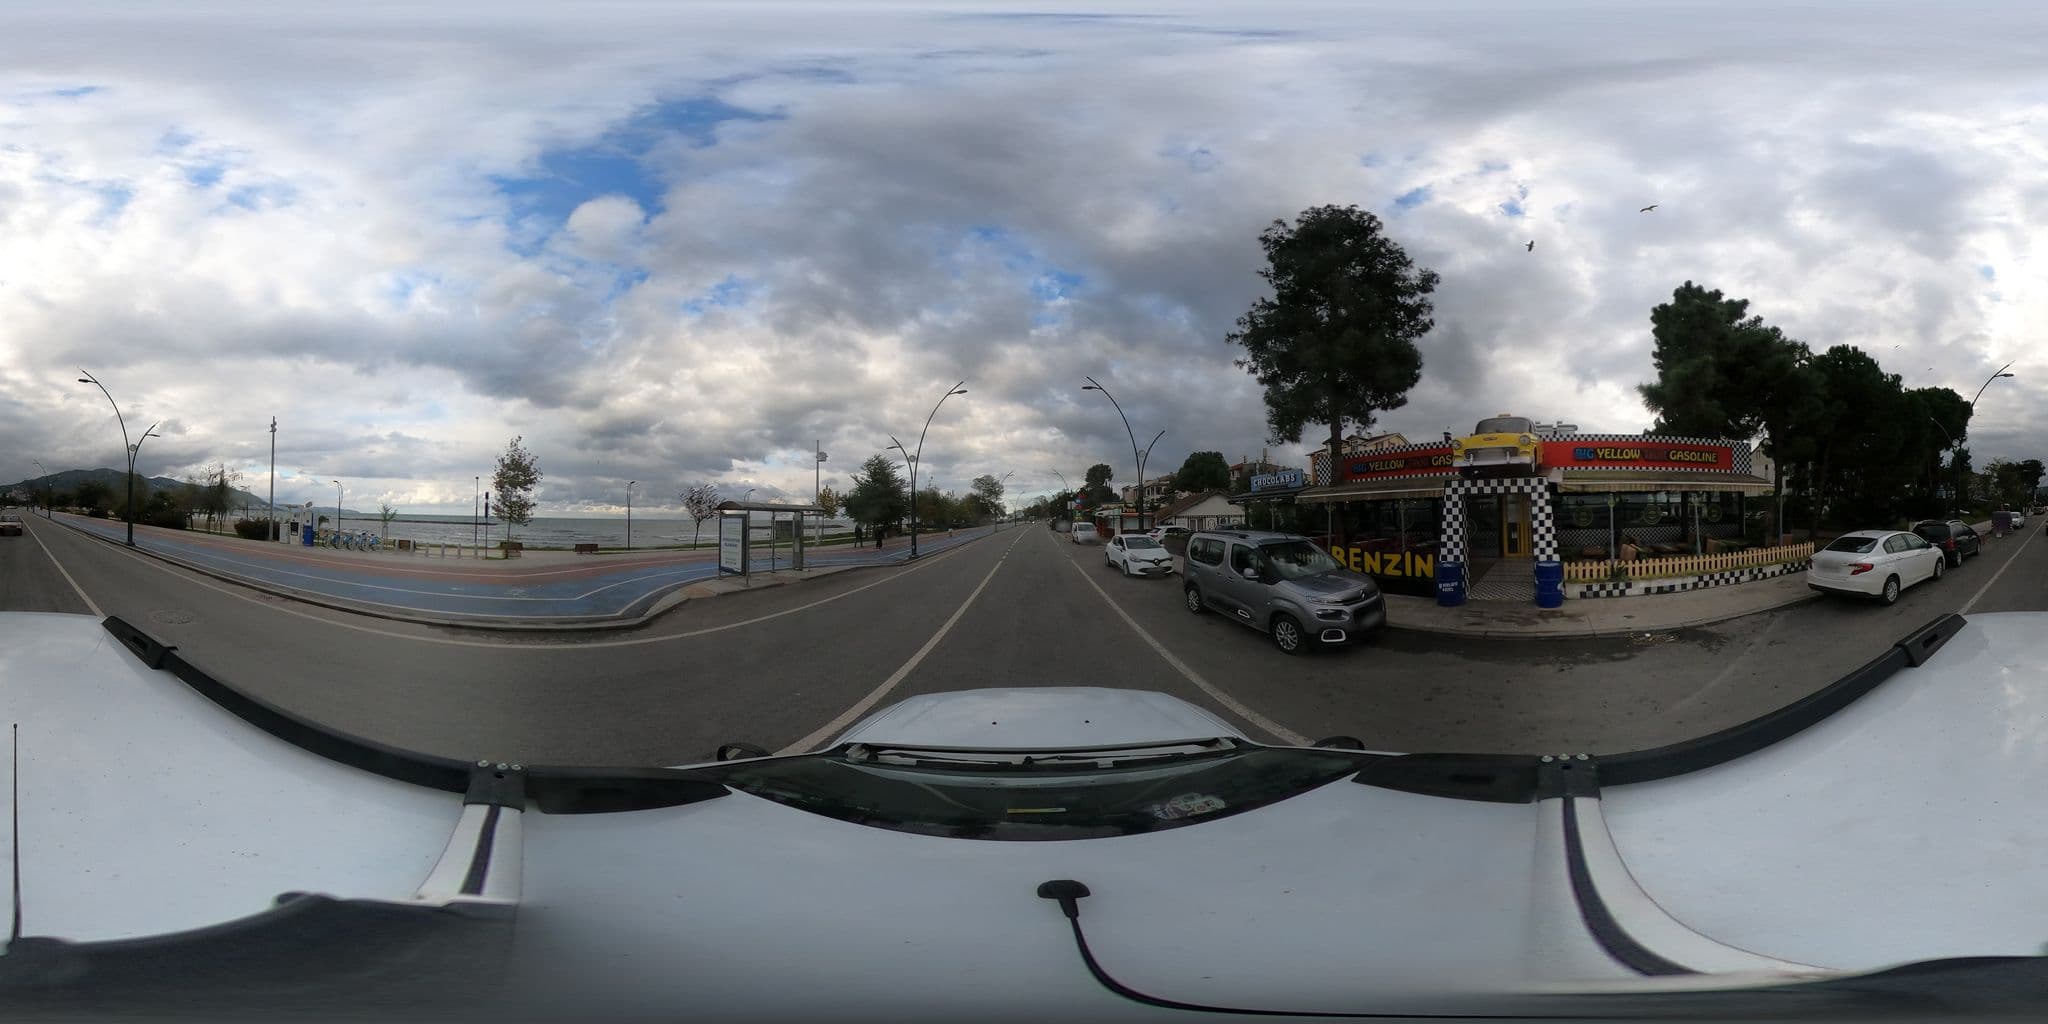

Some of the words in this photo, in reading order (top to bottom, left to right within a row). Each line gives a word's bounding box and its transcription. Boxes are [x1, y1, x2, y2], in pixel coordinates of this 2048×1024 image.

[1369, 459, 1405, 471] YELLOW
[1431, 454, 1454, 467] GAS
[1597, 448, 1641, 459] YELLOW
[1669, 450, 1718, 462] GASOLINE
[1253, 473, 1296, 487] CHOCOLABS
[1331, 545, 1435, 578] BENZIN
